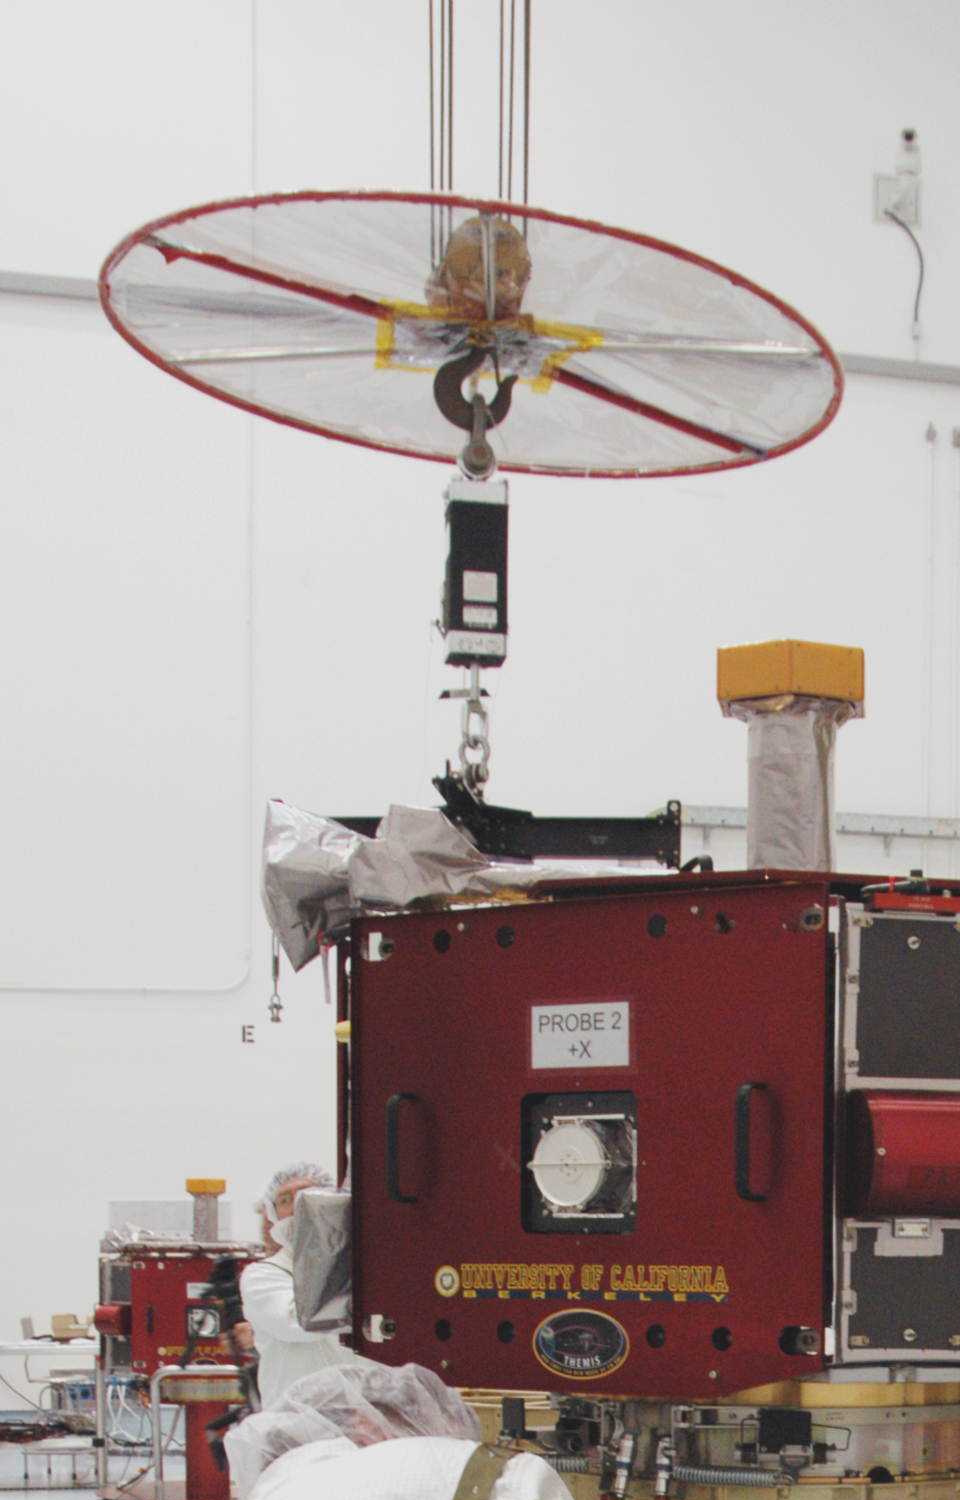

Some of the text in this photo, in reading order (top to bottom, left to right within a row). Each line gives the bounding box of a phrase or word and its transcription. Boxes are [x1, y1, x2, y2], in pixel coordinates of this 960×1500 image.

[538, 1011, 622, 1033] PROBE 2
[242, 1024, 255, 1043] E
[568, 1040, 592, 1059] +X
[460, 1264, 729, 1292] UNIVERSITY OF CALIFORNIA
[463, 1290, 726, 1302] BERKELEY
[564, 1355, 601, 1369] THEMIS
